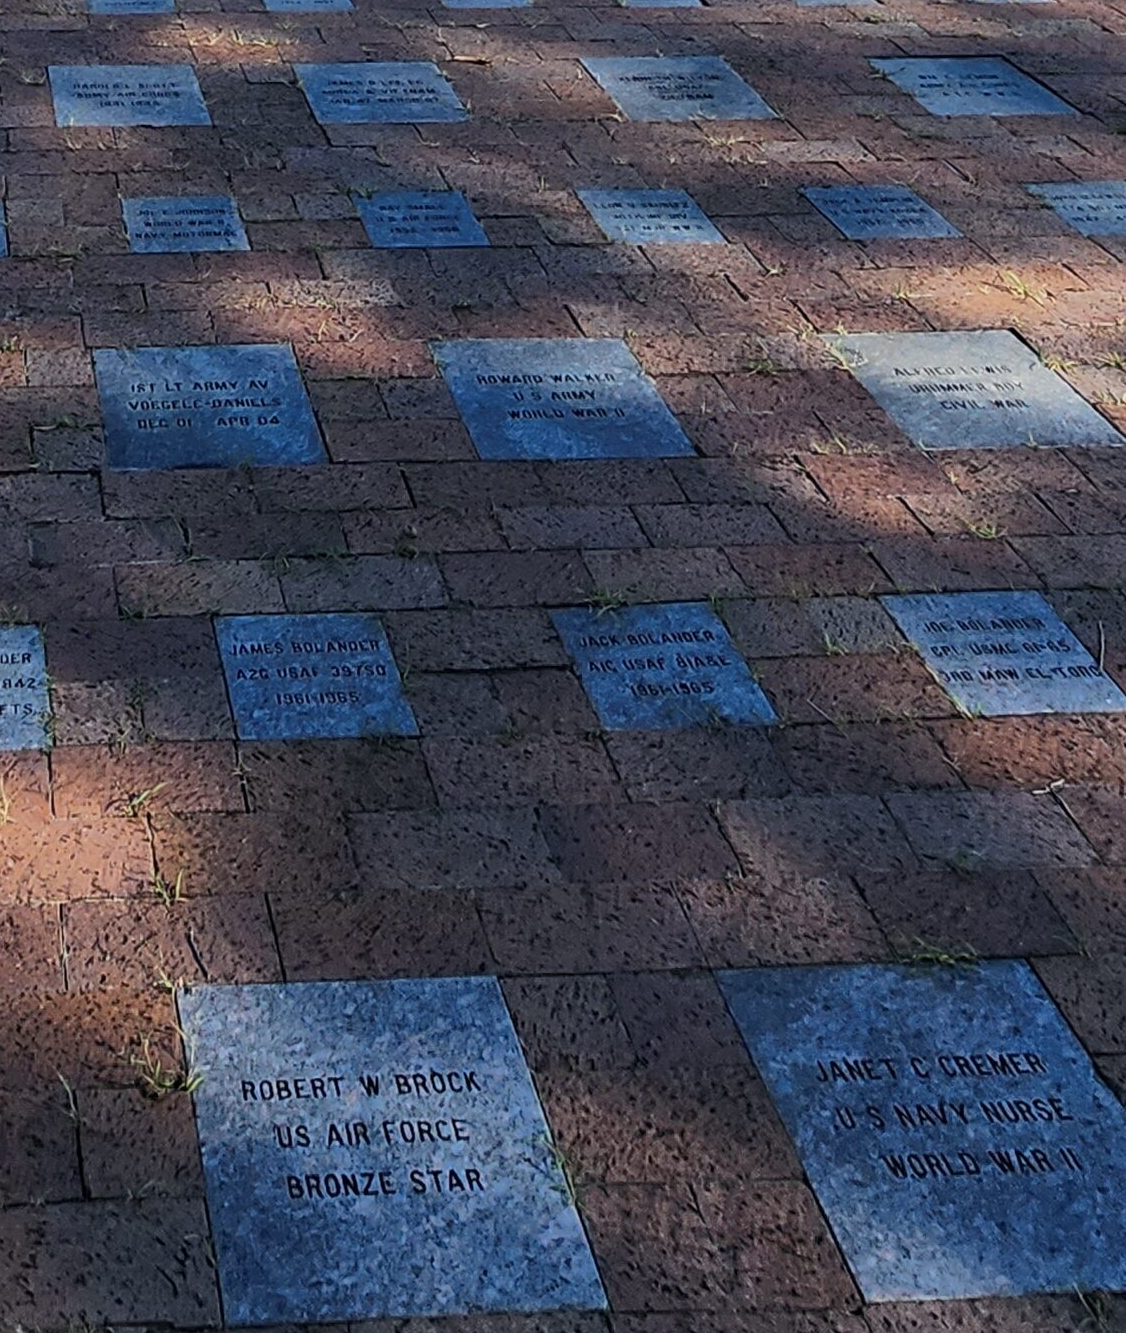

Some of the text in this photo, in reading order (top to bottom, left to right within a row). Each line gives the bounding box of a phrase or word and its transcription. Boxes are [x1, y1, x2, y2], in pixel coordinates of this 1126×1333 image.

[192, 382, 238, 392] ARMY
[229, 639, 381, 655] JAMES BOLANDER
[580, 630, 716, 649] JACK BOLANDER
[624, 655, 666, 671] USAF
[817, 1053, 1046, 1082] JANET C CREMER
[242, 1069, 482, 1101] ROBERT W BROCK
[837, 1097, 1074, 1130] U S NAVY NURSE
[328, 1122, 371, 1148] AIR
[383, 1119, 471, 1144] FORCE
[884, 1148, 1082, 1179] WORLD WAR II
[288, 1168, 485, 1200] BRONZE STAR
